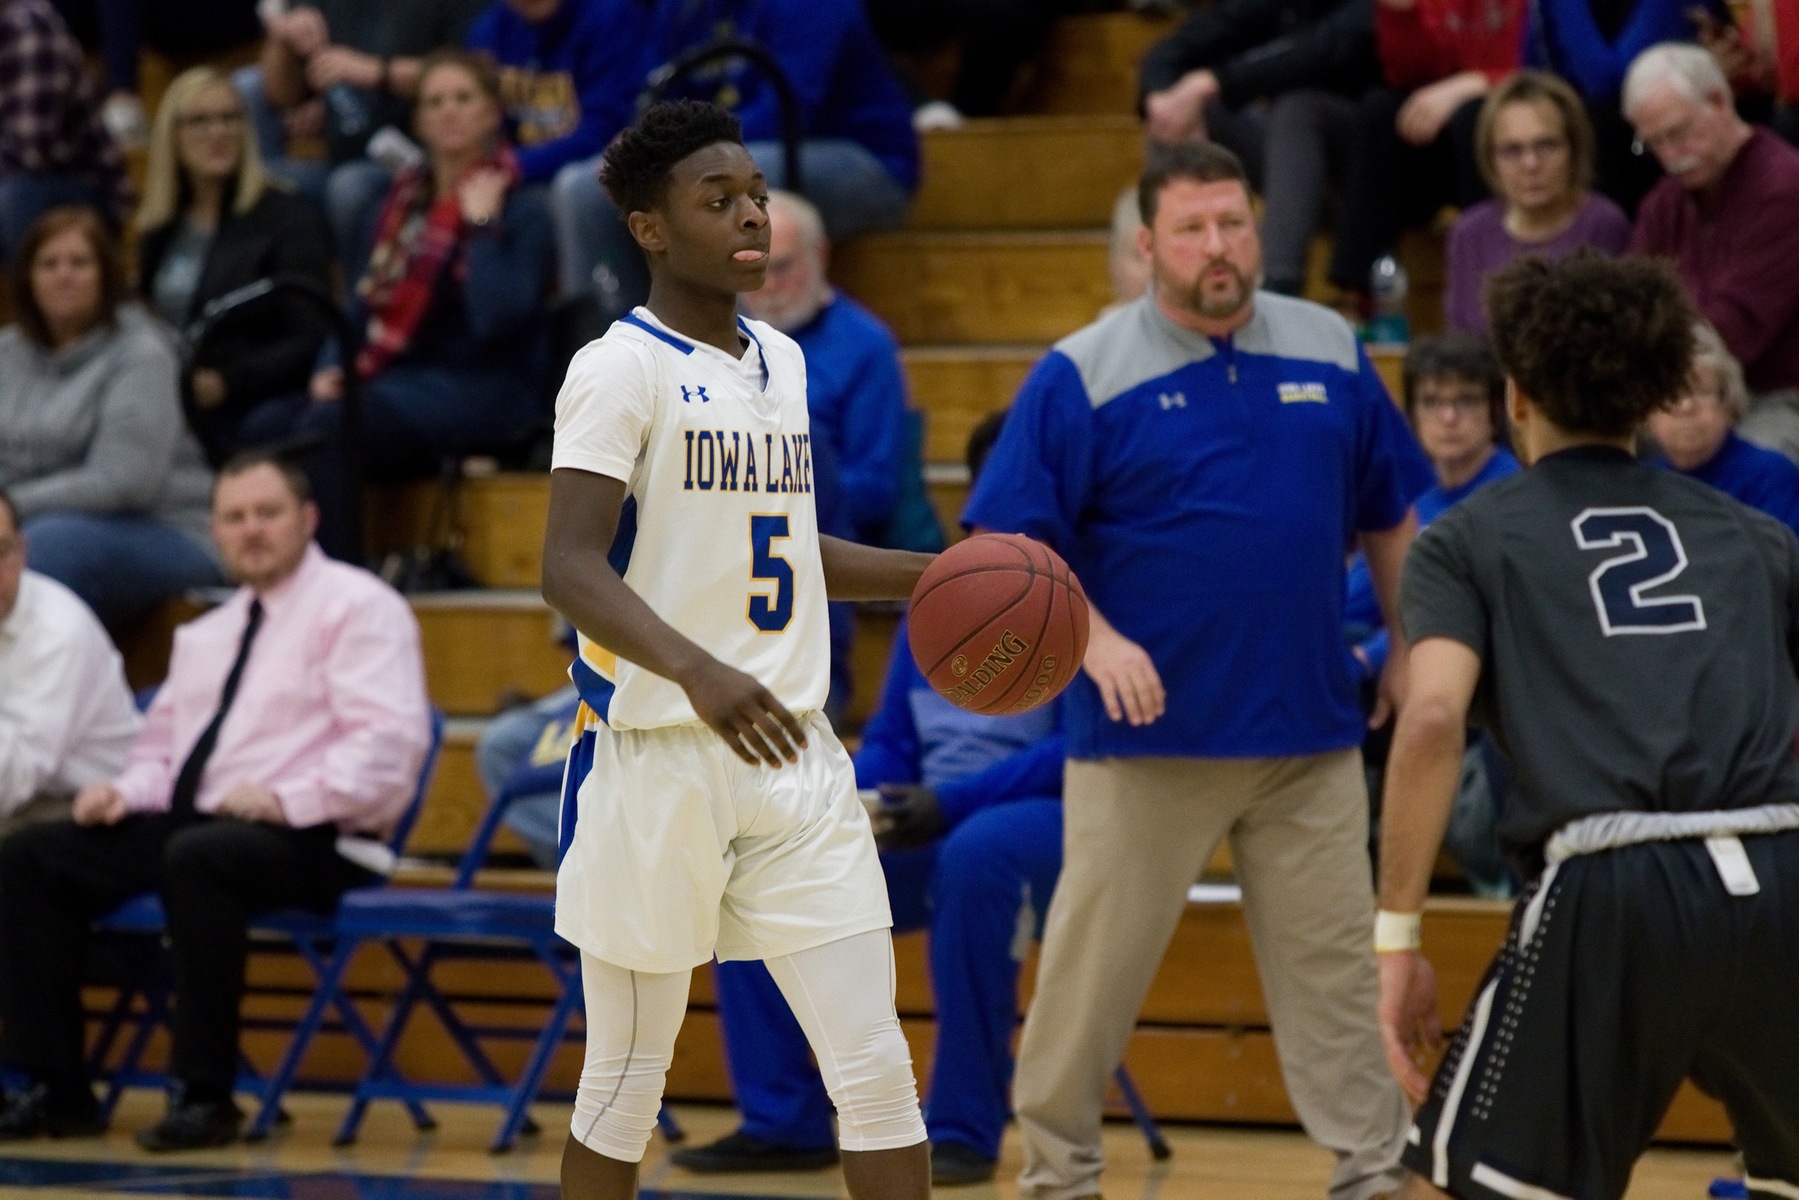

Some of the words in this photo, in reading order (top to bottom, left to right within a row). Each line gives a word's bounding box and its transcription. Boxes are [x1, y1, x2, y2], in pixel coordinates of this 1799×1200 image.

[683, 429, 759, 492] IOWA
[745, 511, 797, 634] 5
[1570, 506, 1707, 637] 2
